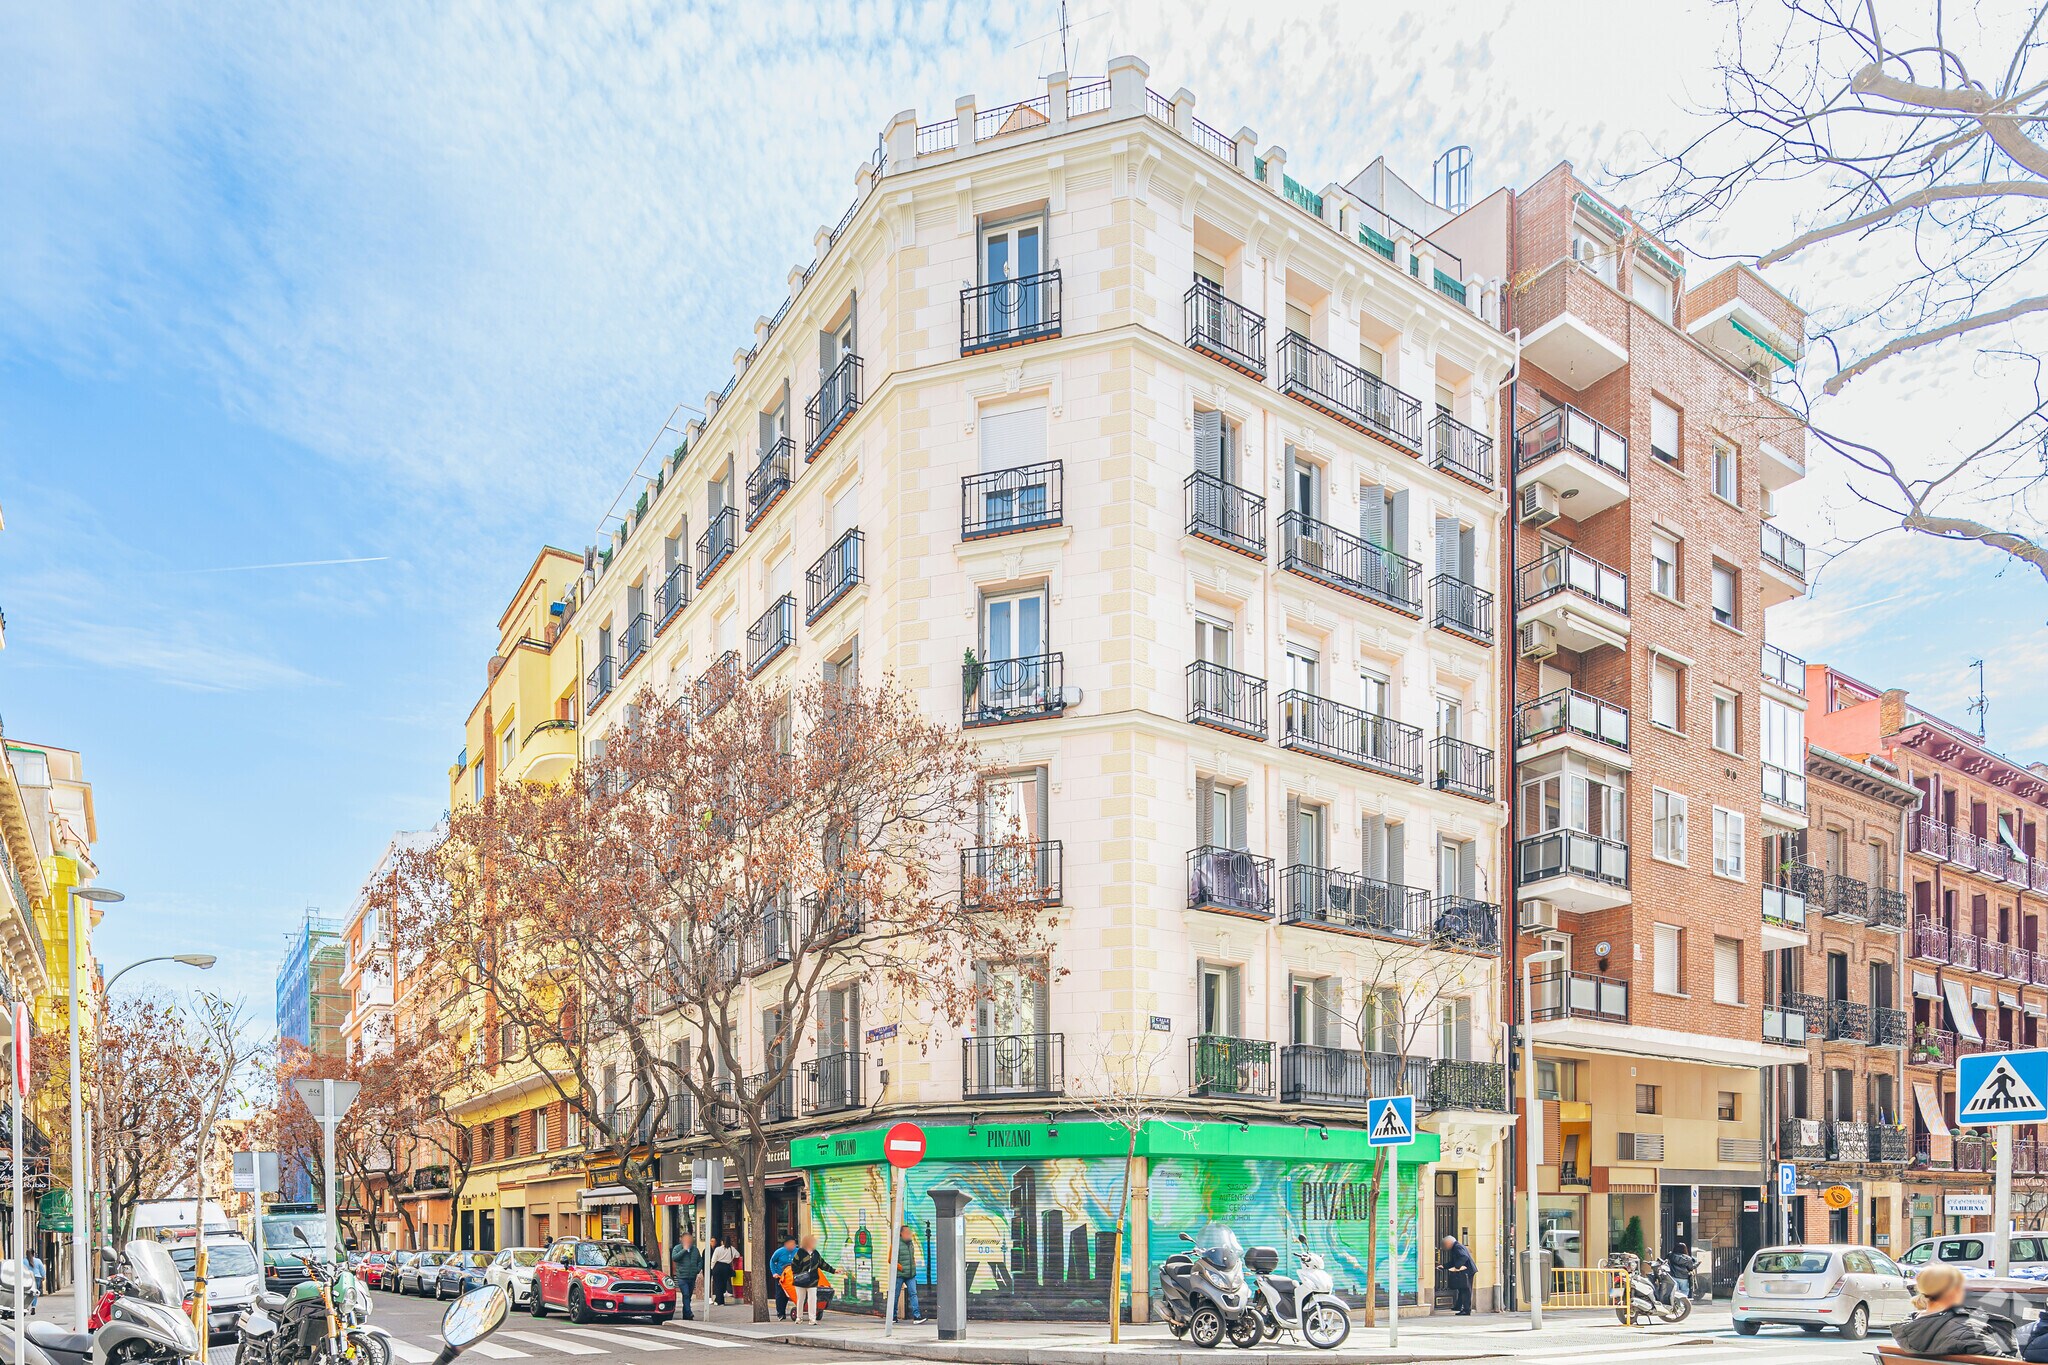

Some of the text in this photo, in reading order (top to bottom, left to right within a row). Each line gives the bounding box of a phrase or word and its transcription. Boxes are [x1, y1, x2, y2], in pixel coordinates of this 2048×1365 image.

[835, 1139, 857, 1157] PINZANO
[987, 1129, 1031, 1148] PINZANO
[1301, 1182, 1368, 1220] PINZANO
